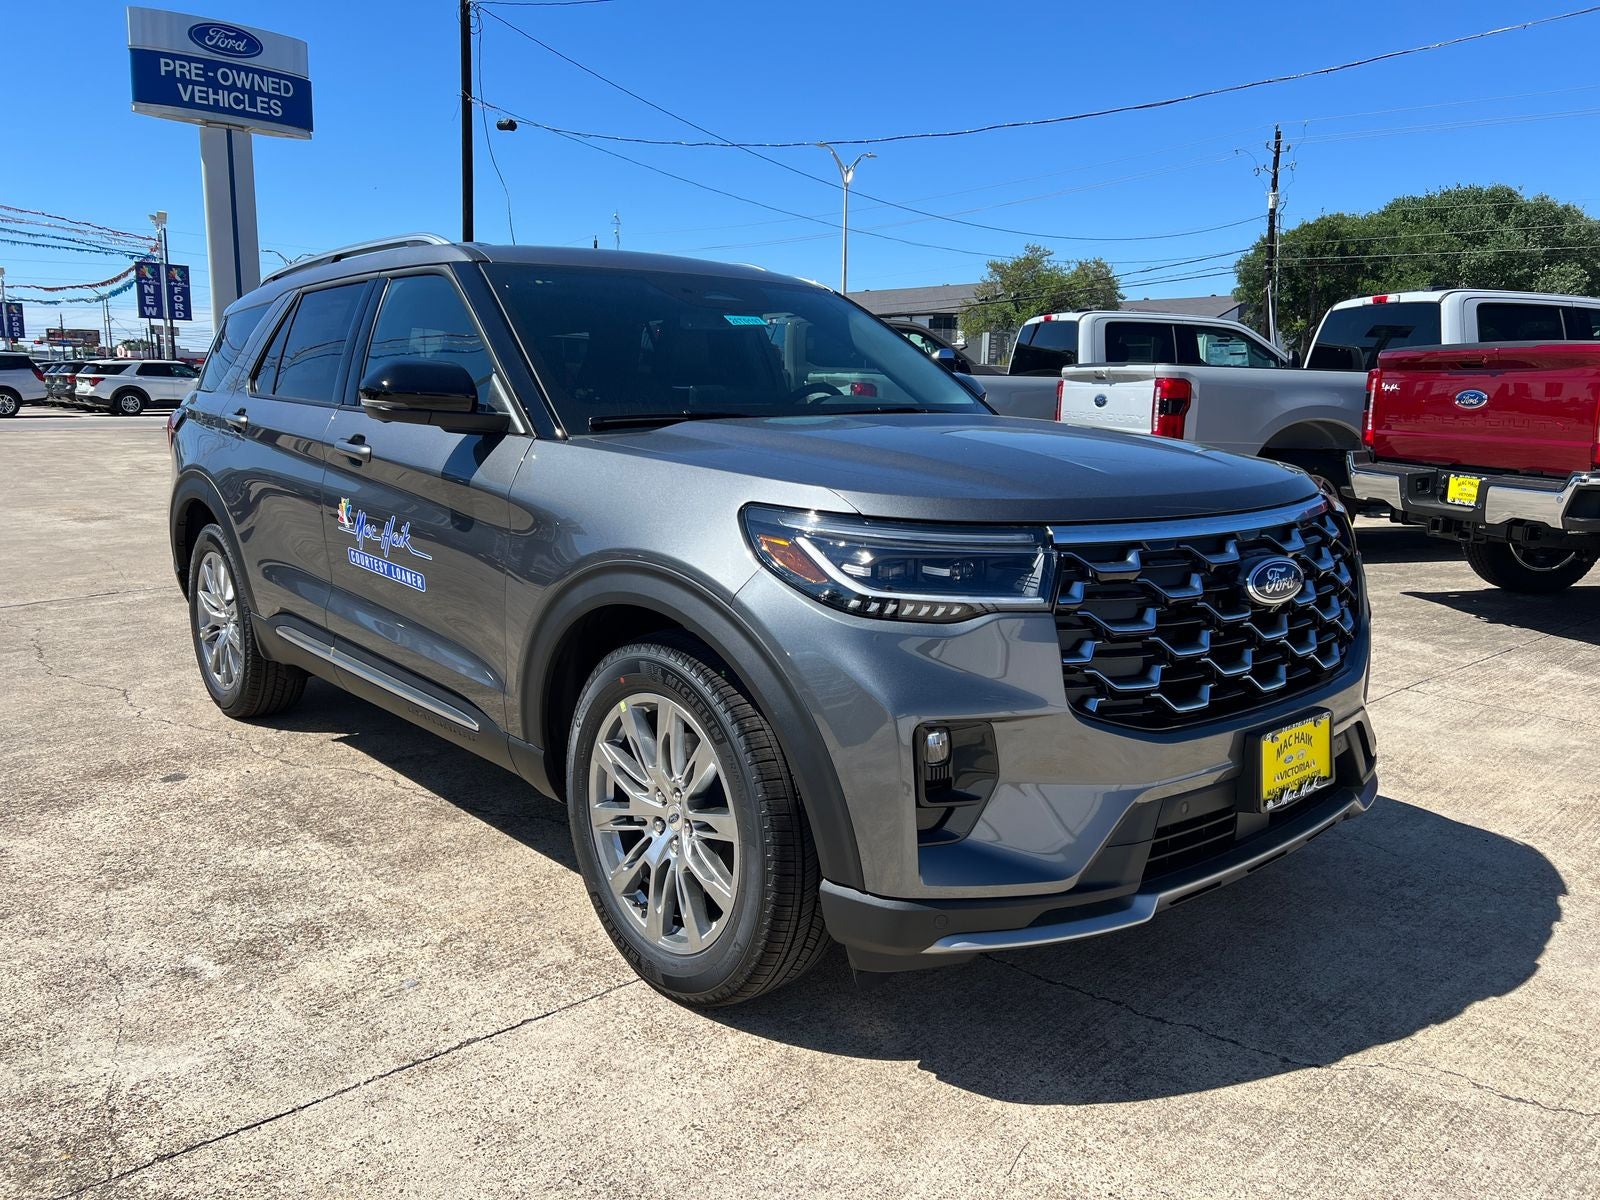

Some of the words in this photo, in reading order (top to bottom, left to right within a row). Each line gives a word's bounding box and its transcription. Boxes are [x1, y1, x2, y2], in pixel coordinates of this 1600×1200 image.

[205, 27, 247, 52] Ford
[159, 57, 294, 98] PRE-OWNED
[177, 83, 283, 117] VEHICLES
[143, 284, 157, 316] NEW
[173, 286, 185, 318] FORD
[12, 316, 20, 337] FORD
[1461, 393, 1479, 404] Ford
[342, 509, 381, 551] Mac
[350, 550, 389, 575] COURTESY
[391, 565, 423, 589] LOANER
[1265, 567, 1295, 594] Ford
[664, 674, 723, 741] MICHELIN
[1276, 734, 1293, 760] MAC
[1294, 731, 1313, 748] HAIK
[1279, 760, 1310, 780] VICTORIA
